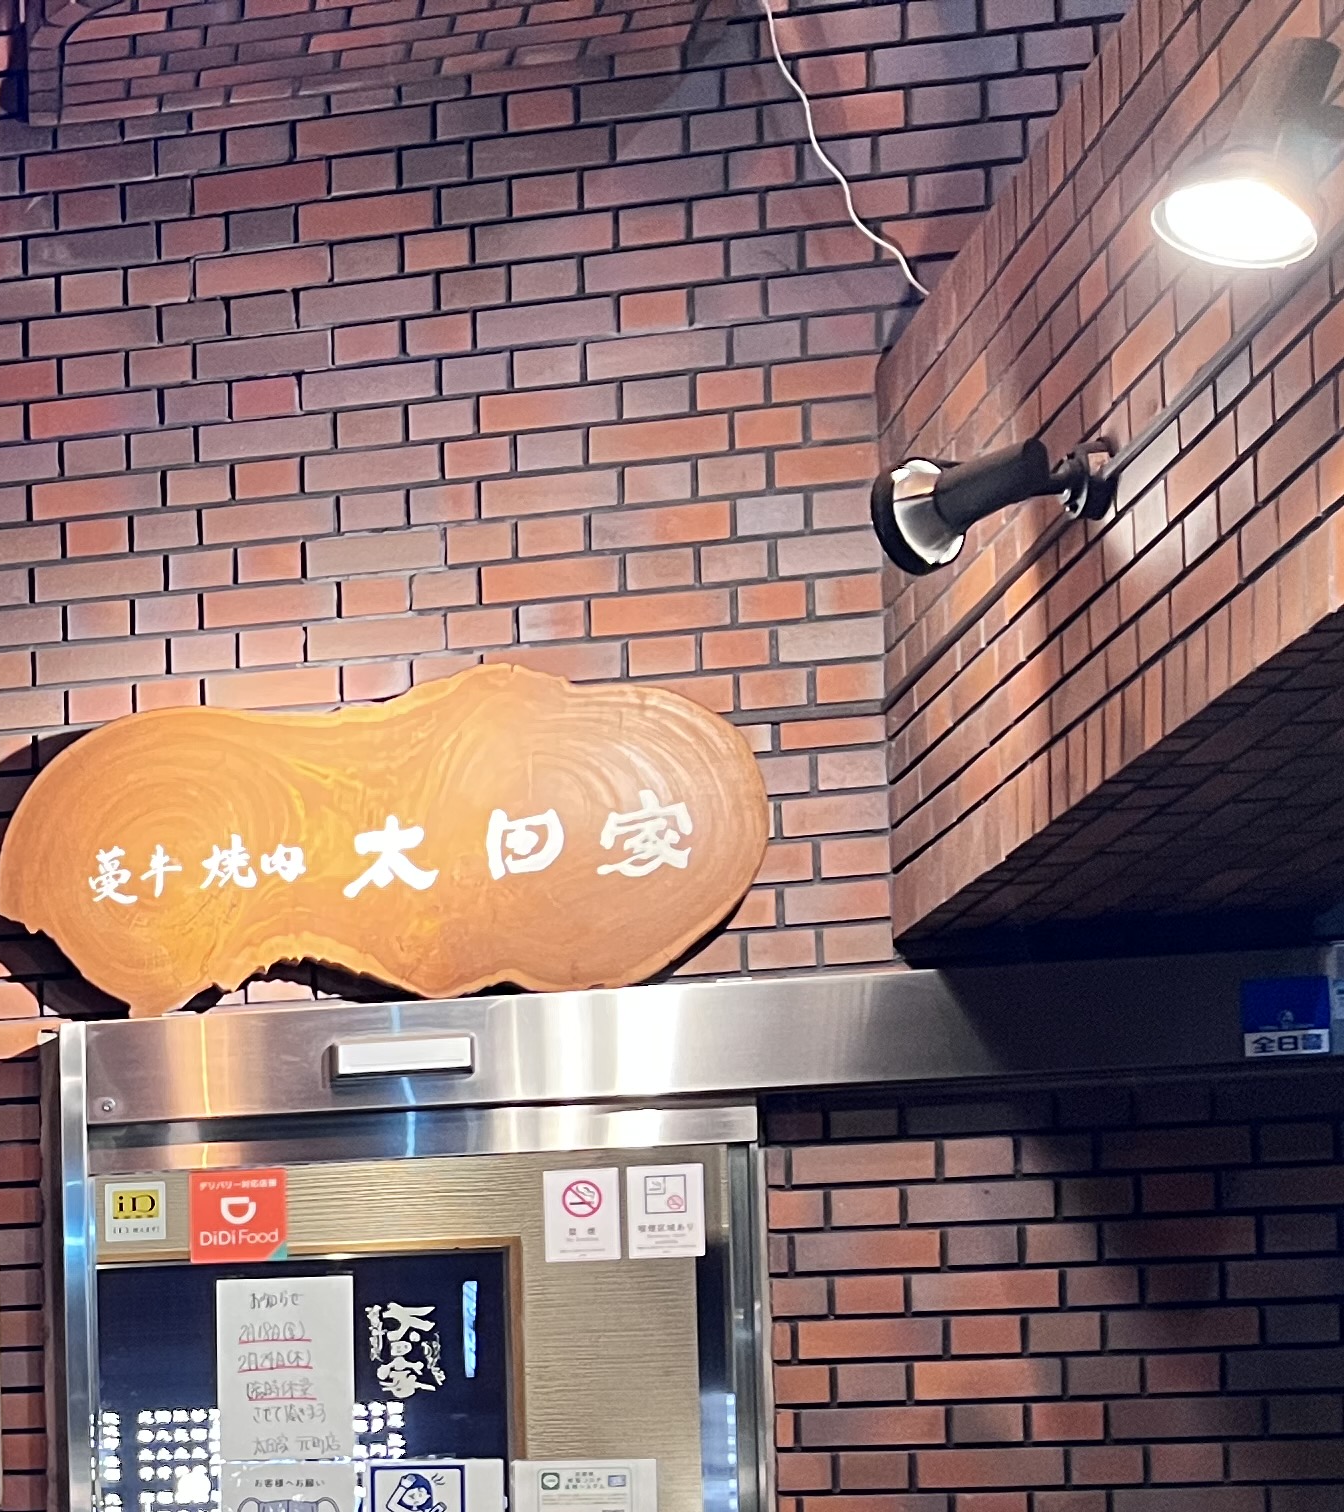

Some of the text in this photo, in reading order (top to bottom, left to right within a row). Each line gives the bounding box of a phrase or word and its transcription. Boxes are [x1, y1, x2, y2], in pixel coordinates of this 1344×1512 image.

[118, 1195, 156, 1213] iD
[200, 1228, 279, 1246] DiDi Food
